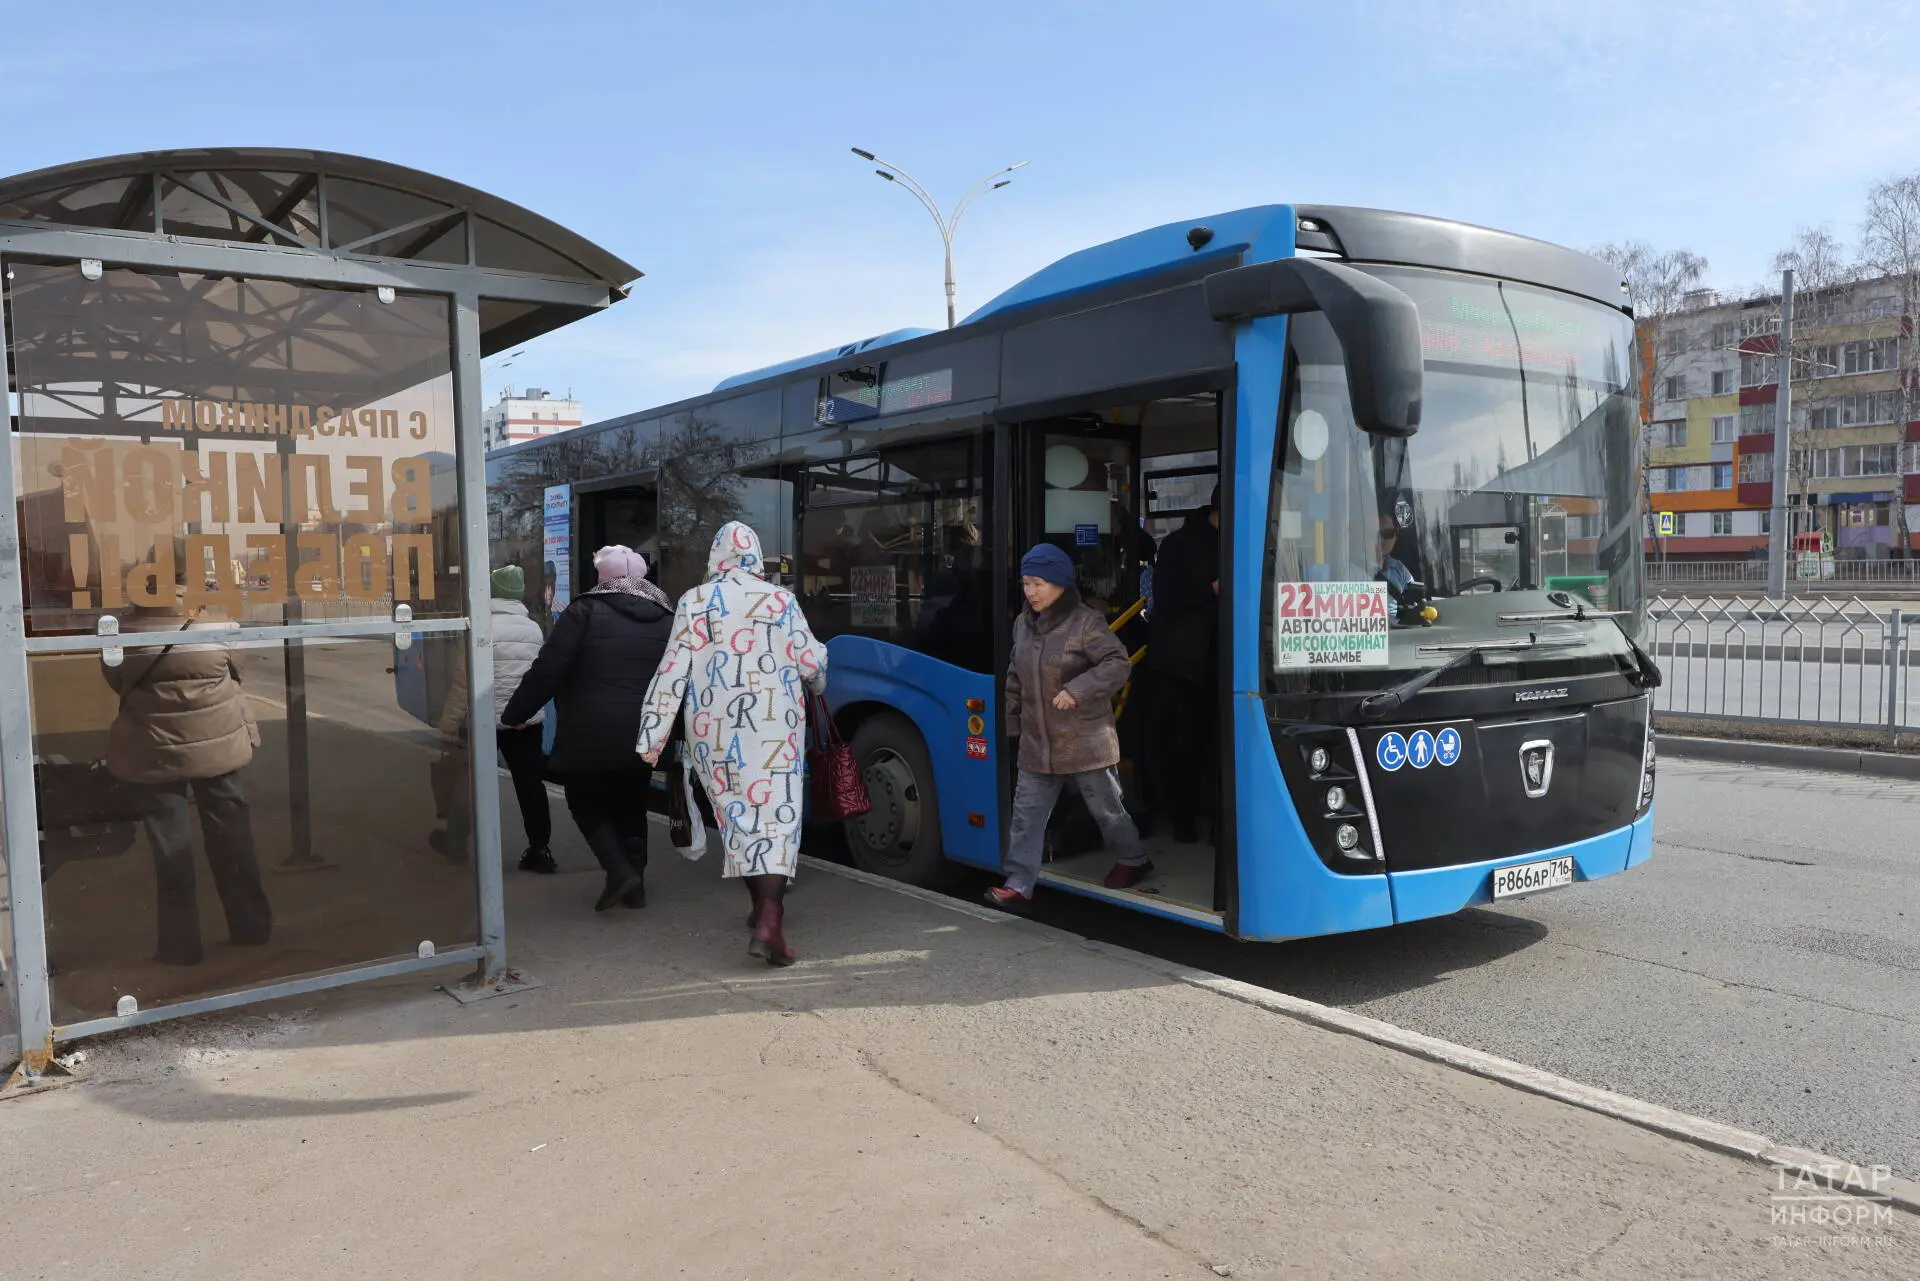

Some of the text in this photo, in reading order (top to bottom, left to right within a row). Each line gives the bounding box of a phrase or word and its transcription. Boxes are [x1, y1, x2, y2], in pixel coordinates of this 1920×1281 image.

[1280, 584, 1314, 618] 22
[1314, 584, 1370, 595] Ш.УСМАНОВА
[744, 592, 771, 619] Z
[1315, 594, 1386, 617] МИРА
[1281, 617, 1387, 634] АВТОСТАНЦИЯ
[730, 628, 755, 654] G
[1281, 634, 1387, 651] МЯСОКОМБИНАТ
[1308, 651, 1362, 664] ЗАКАМЬЕ
[726, 692, 758, 733] R
[760, 740, 786, 770] Z
[747, 779, 773, 805] G
[745, 838, 773, 874] R
